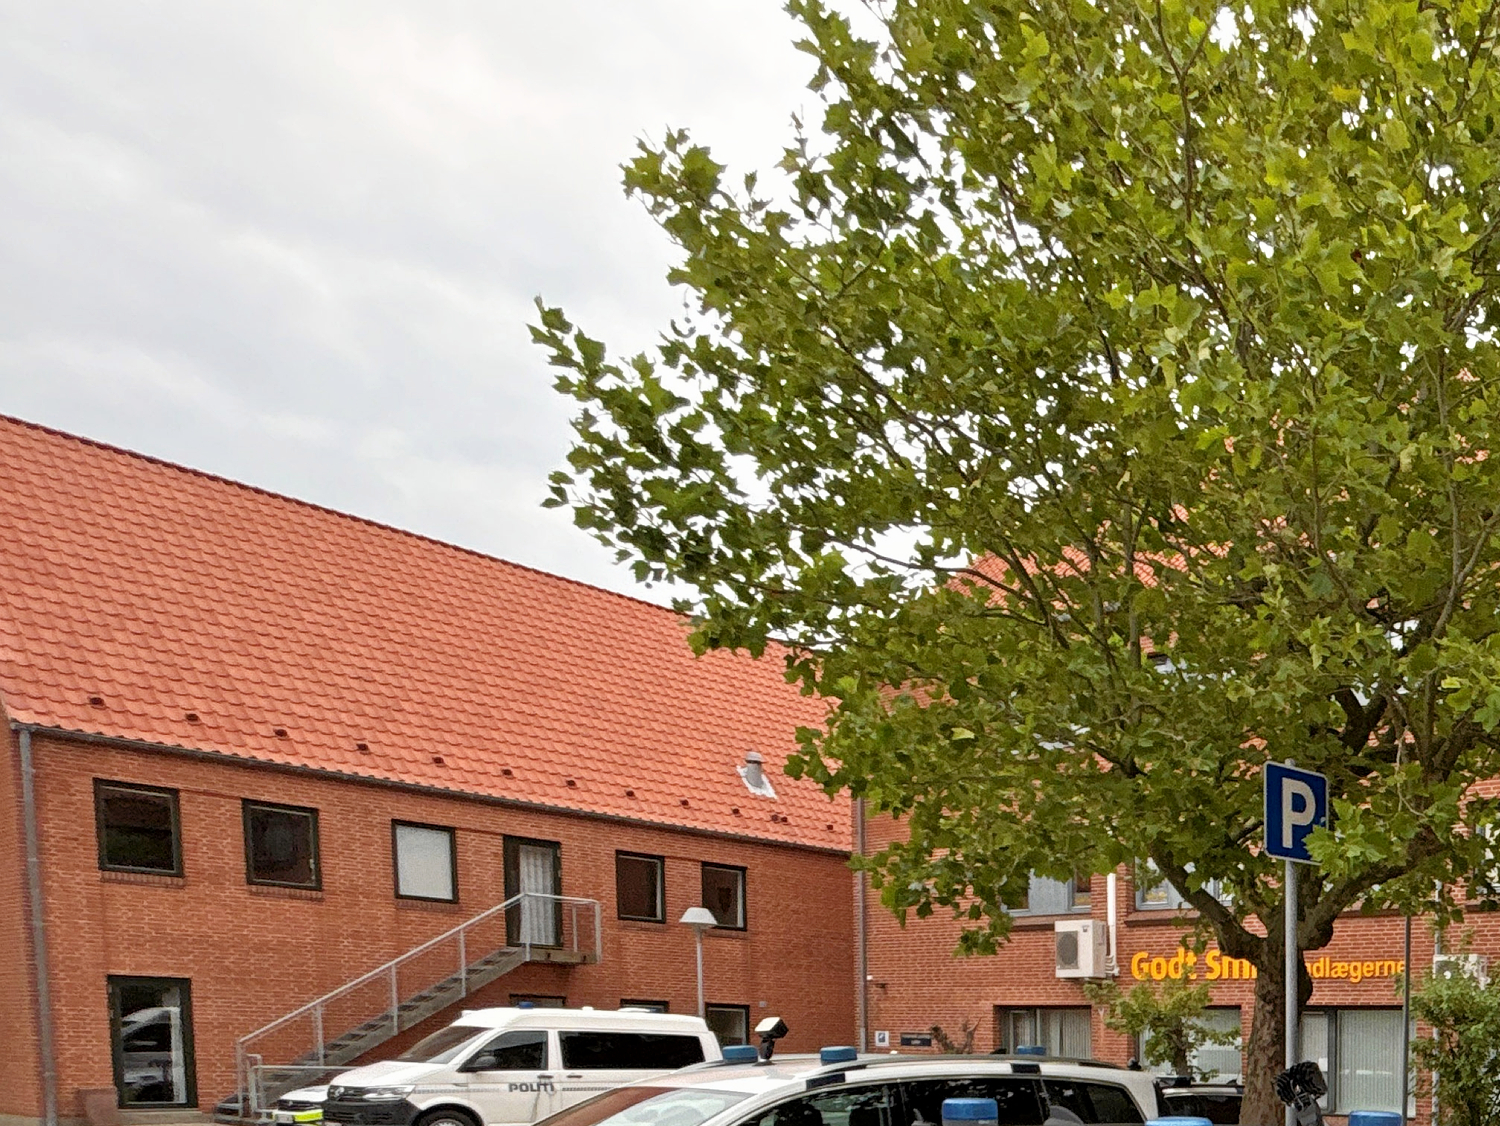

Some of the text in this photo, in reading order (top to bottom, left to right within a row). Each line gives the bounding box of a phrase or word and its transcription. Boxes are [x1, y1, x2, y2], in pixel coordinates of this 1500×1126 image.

[1281, 777, 1316, 849] P
[1131, 946, 1197, 980] Godt
[1205, 949, 1258, 980] Smi
[508, 1082, 555, 1093] POLITI
